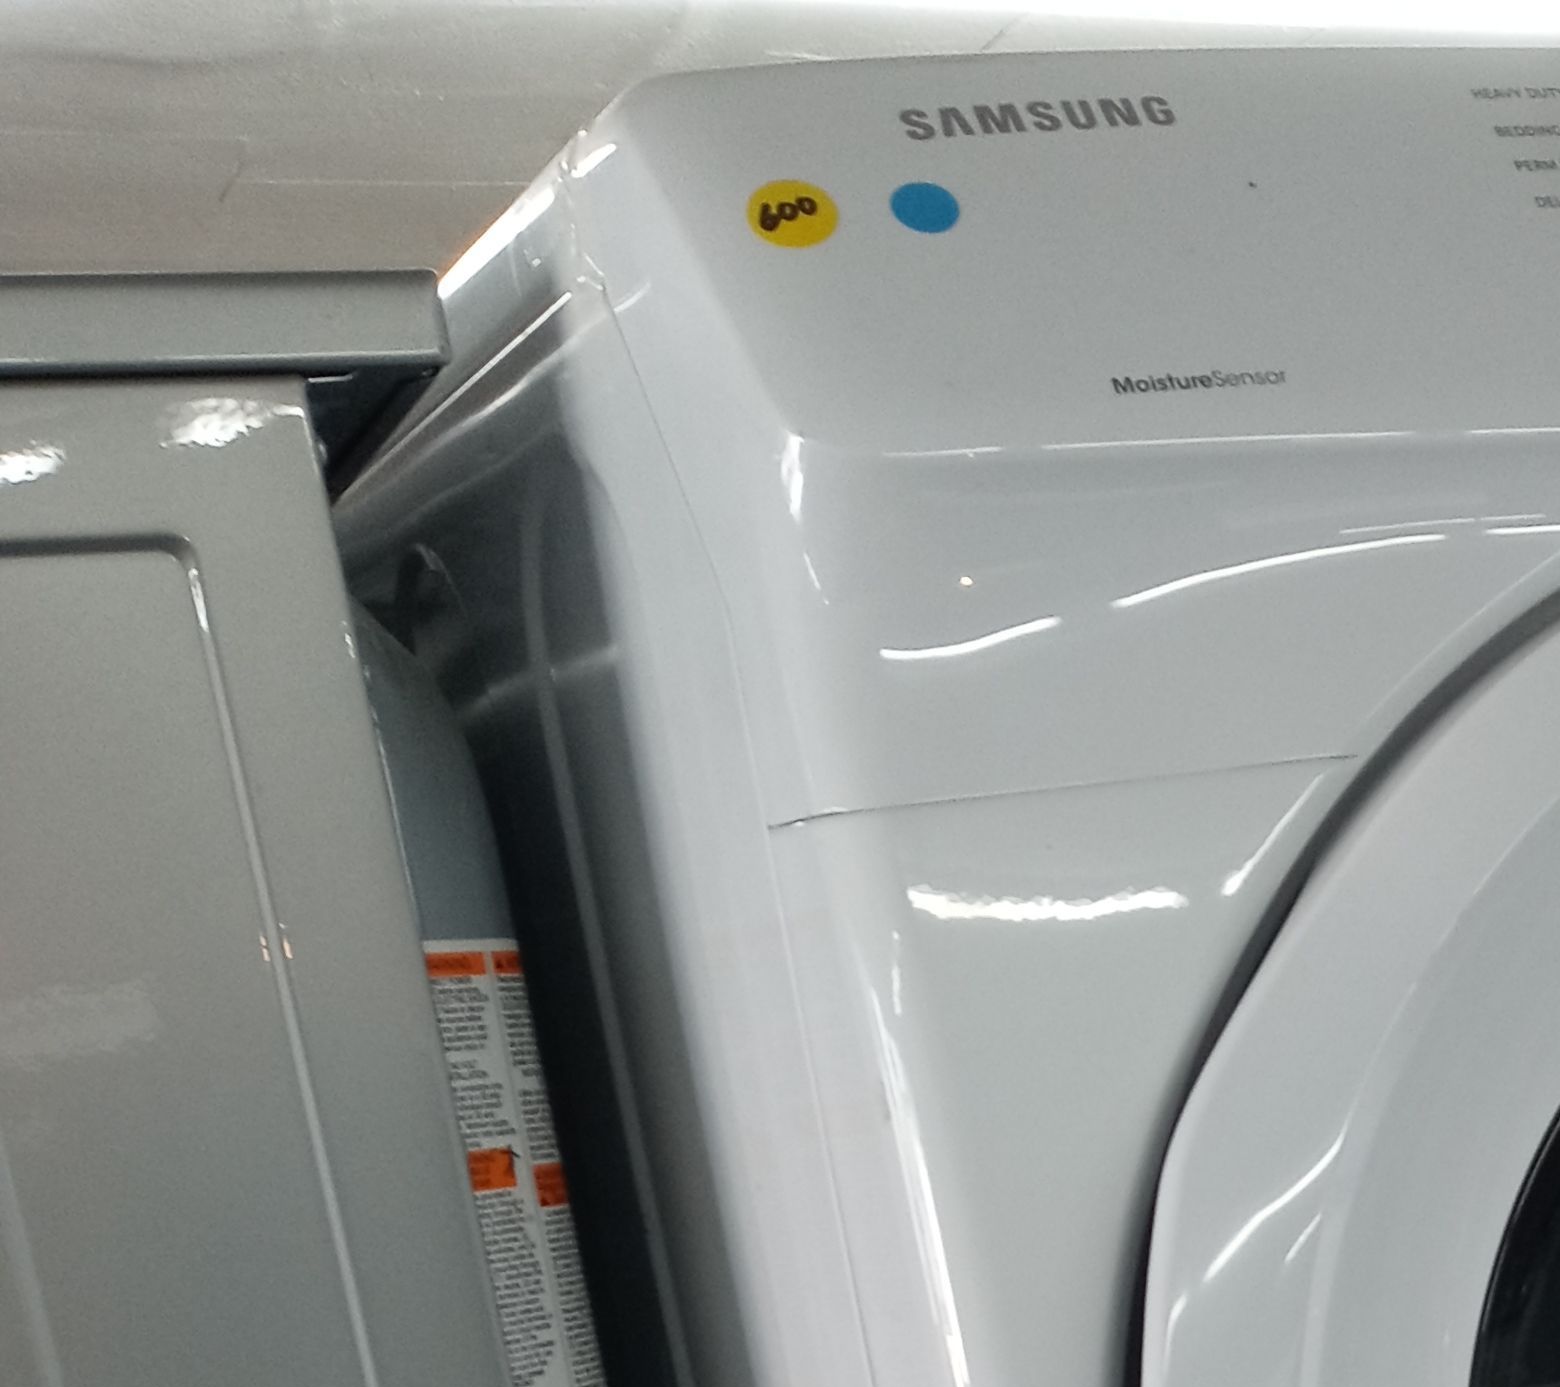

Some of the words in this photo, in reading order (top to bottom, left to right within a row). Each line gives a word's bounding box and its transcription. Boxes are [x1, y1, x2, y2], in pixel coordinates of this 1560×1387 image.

[1470, 87, 1521, 99] HEAVY
[898, 95, 1177, 141] SAMSUNG
[1513, 159, 1558, 171] PERM
[757, 195, 819, 233] 600
